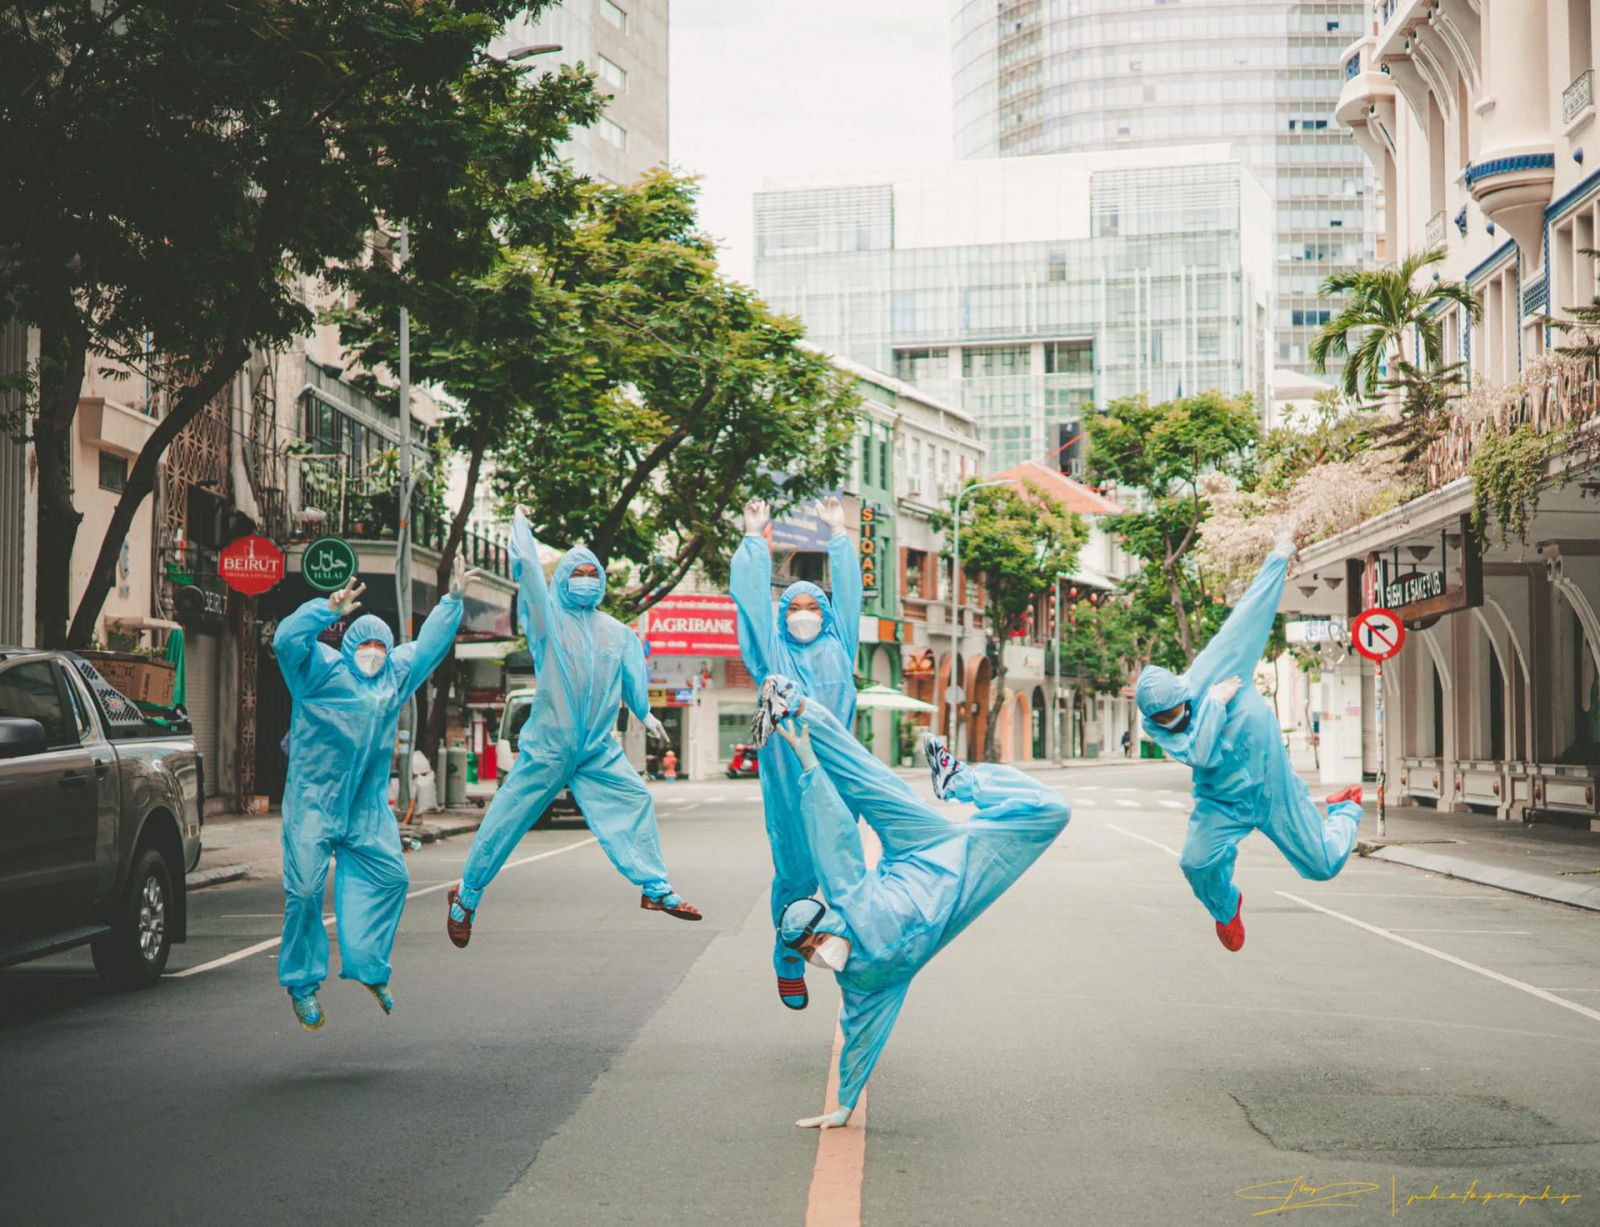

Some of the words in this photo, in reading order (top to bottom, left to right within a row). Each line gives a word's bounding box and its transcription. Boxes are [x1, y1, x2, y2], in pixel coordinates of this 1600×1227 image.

[224, 558, 280, 572] BEIRUT
[314, 572, 343, 580] HALAL
[1410, 576, 1427, 601] SAKE
[650, 617, 735, 634] AGRIBANK
